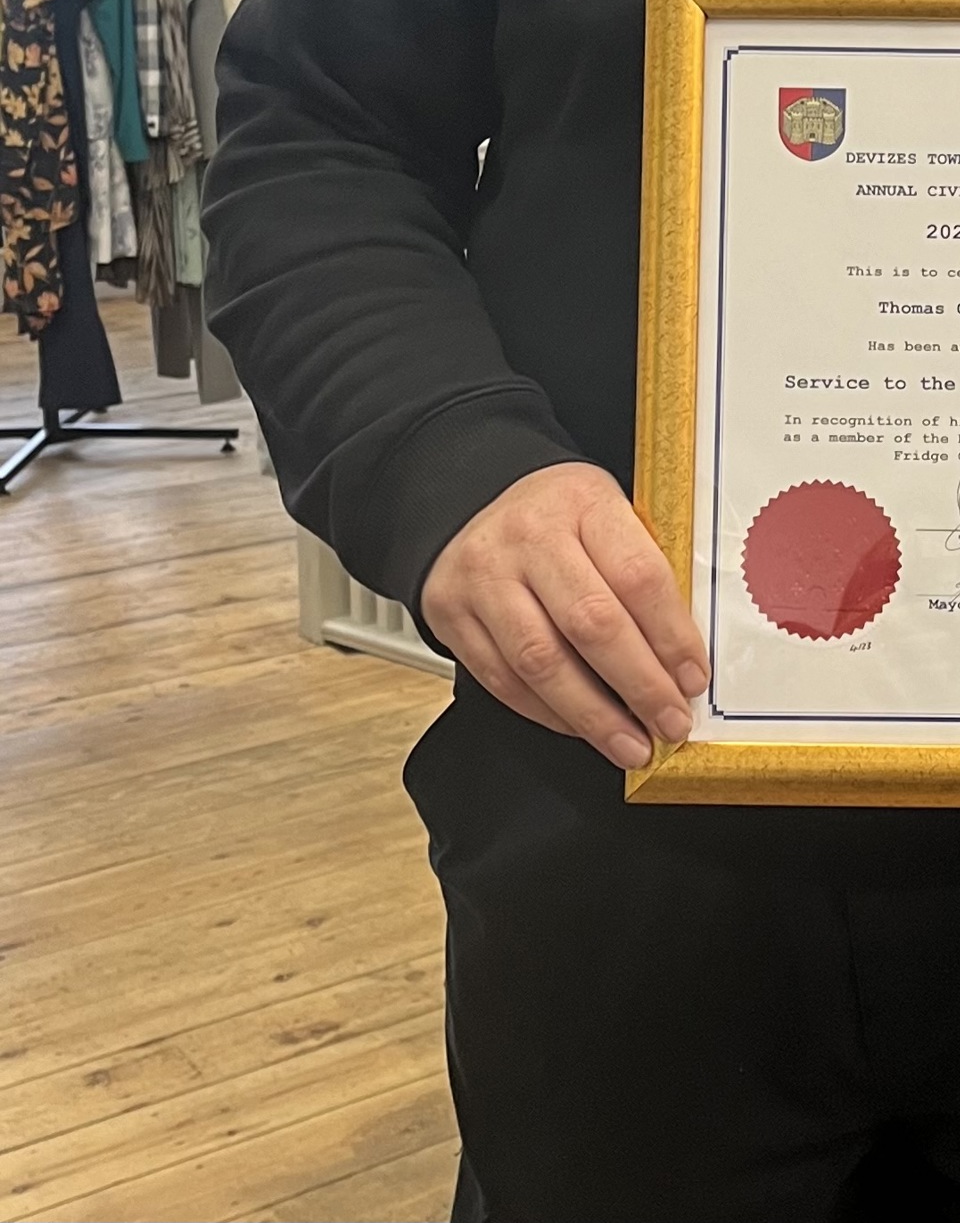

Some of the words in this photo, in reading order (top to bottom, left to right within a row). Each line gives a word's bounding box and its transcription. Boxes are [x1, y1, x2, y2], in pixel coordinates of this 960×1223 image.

[845, 151, 917, 165] DEVIZES
[855, 184, 918, 197] ANNUAL
[846, 265, 883, 277] This
[892, 266, 910, 278] is
[920, 267, 939, 278] to
[878, 300, 945, 315] Thomas
[867, 340, 895, 352] Has
[904, 340, 942, 352] been
[784, 374, 870, 390] Service
[883, 376, 907, 391] to
[919, 375, 956, 391] the
[784, 414, 802, 425] In
[811, 415, 913, 429] recognition
[921, 415, 941, 427] of
[783, 433, 801, 443] as
[810, 433, 820, 443] a
[828, 431, 885, 444] member
[893, 432, 913, 444] of
[922, 432, 949, 445] the
[893, 449, 949, 464] Fridge
